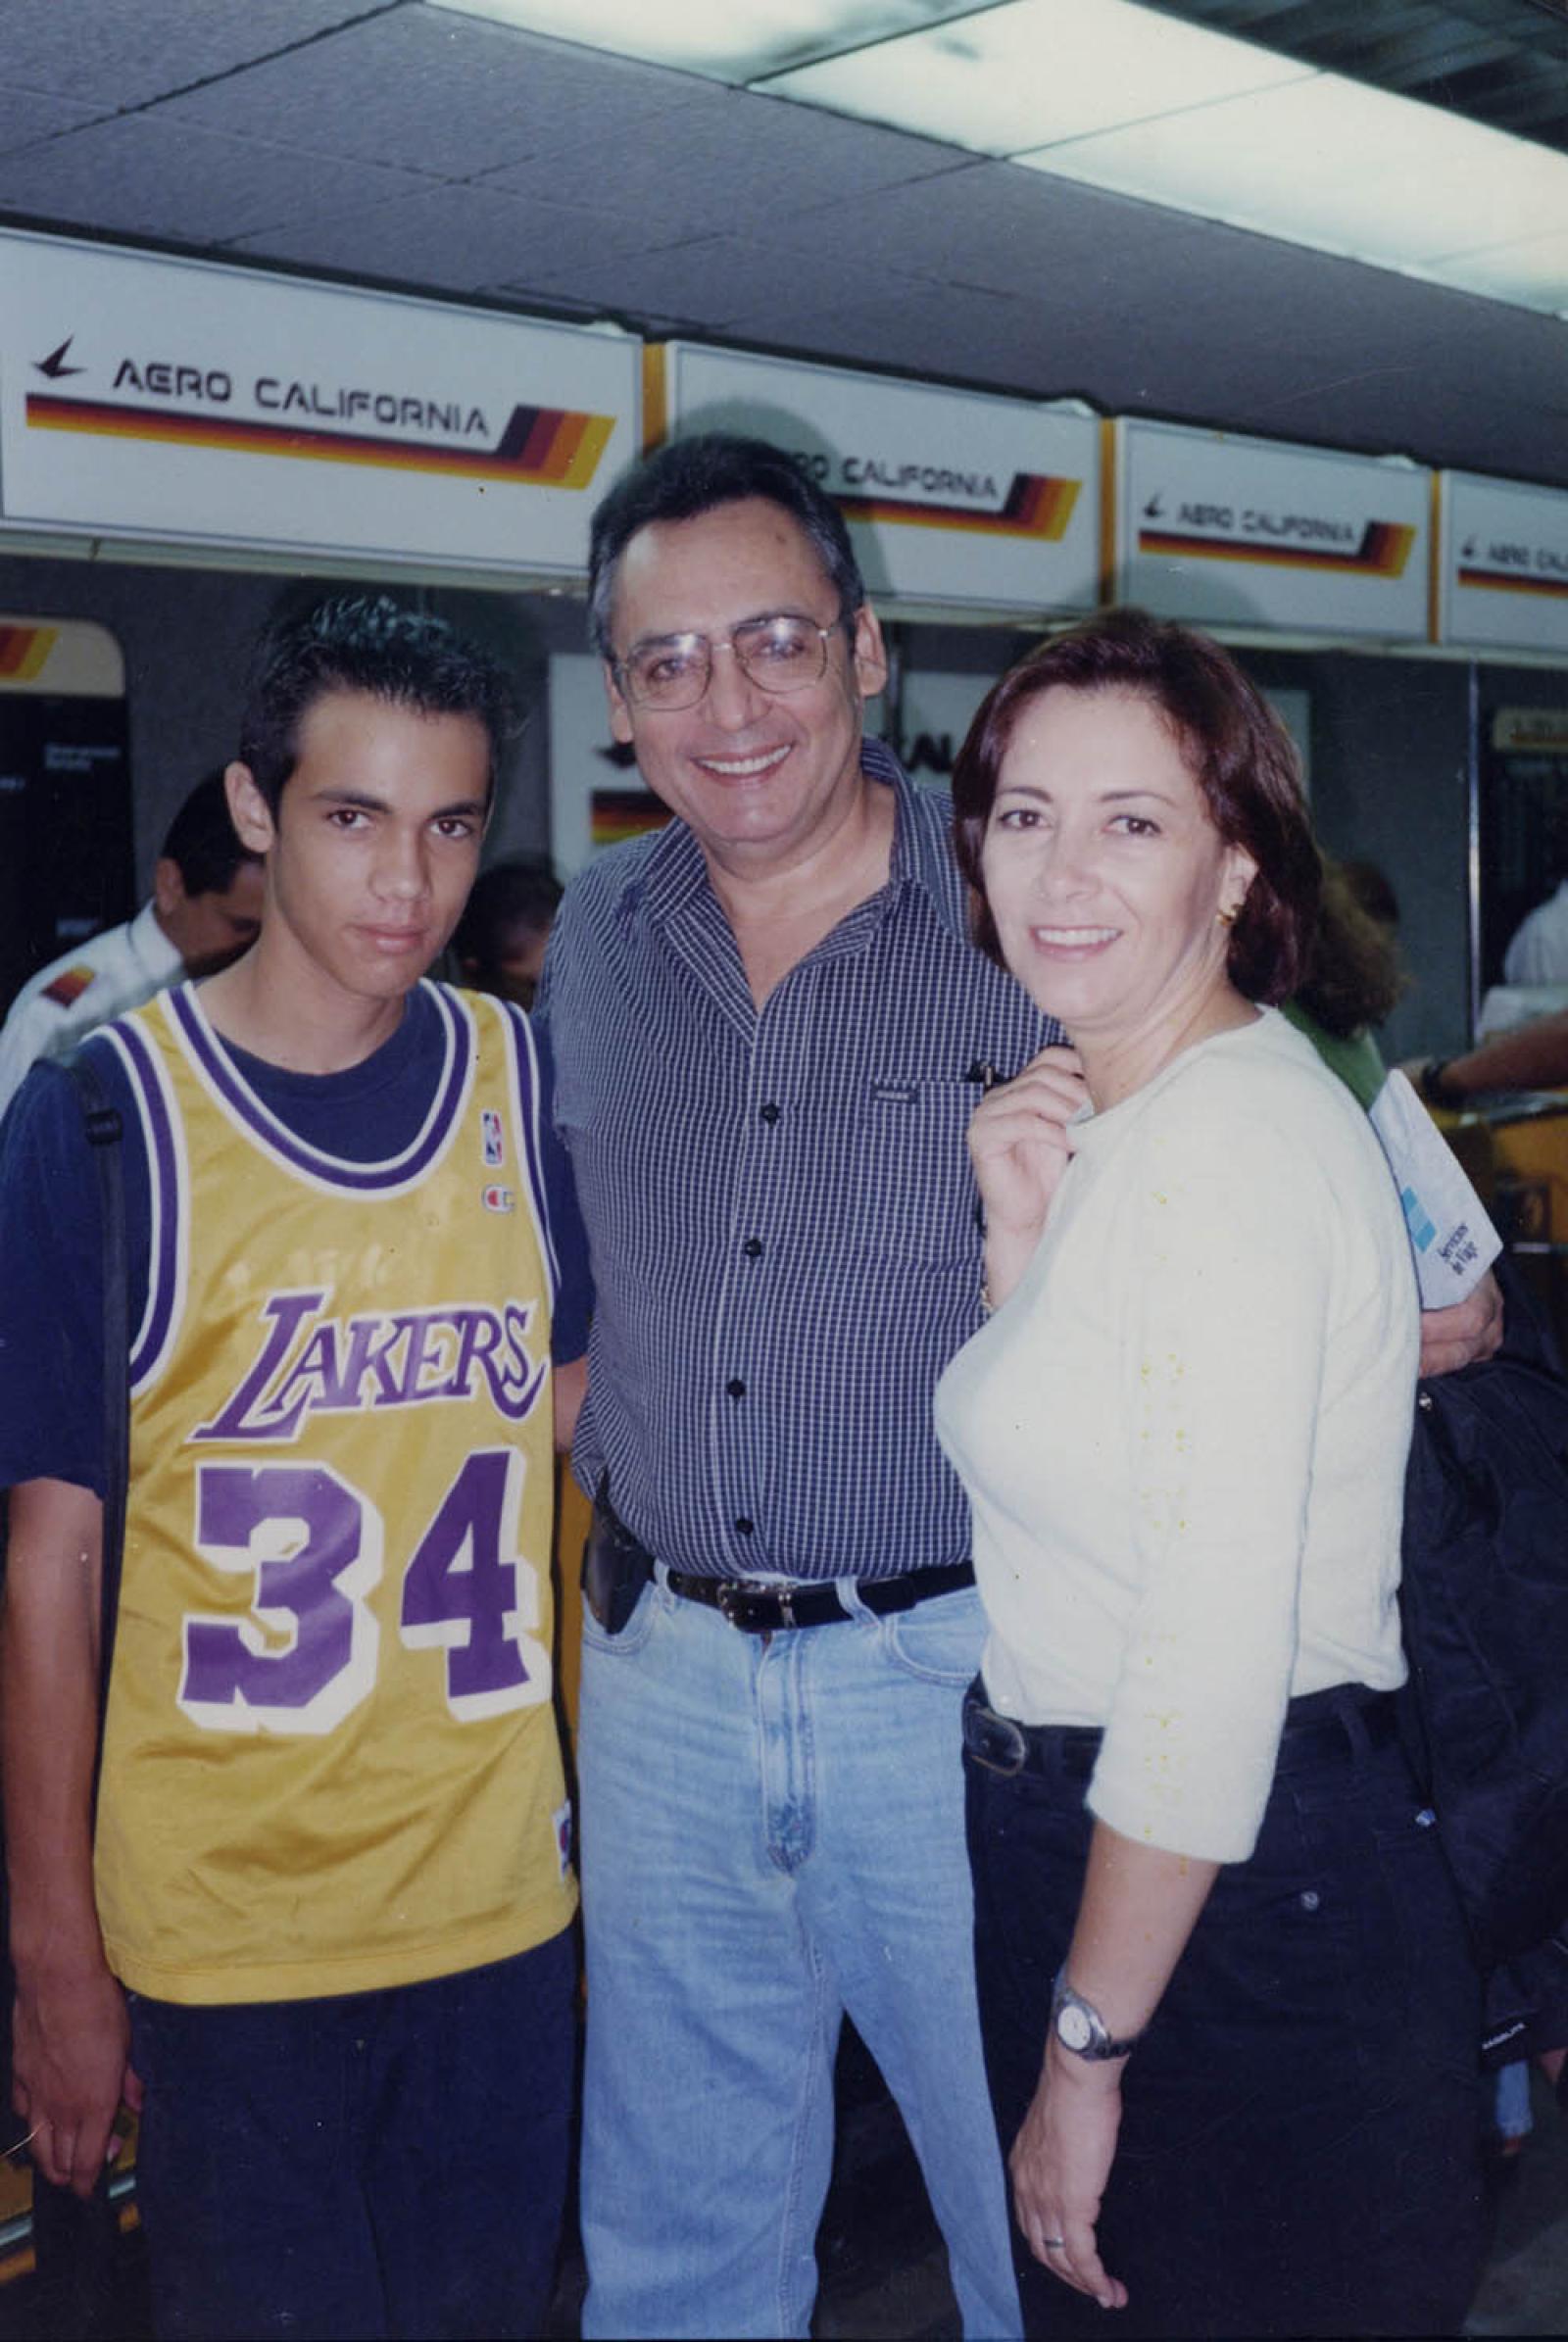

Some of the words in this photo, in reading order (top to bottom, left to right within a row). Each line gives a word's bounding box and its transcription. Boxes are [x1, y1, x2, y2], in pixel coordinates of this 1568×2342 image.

[113, 358, 232, 403] AERO
[255, 378, 491, 437] CALIFORNIA
[843, 458, 998, 498] CALIFORNIA
[1180, 501, 1234, 530] AERO
[1244, 511, 1354, 544] CALIFORNIA
[186, 1285, 551, 1443] LAKERS
[177, 1445, 552, 1734] 34
